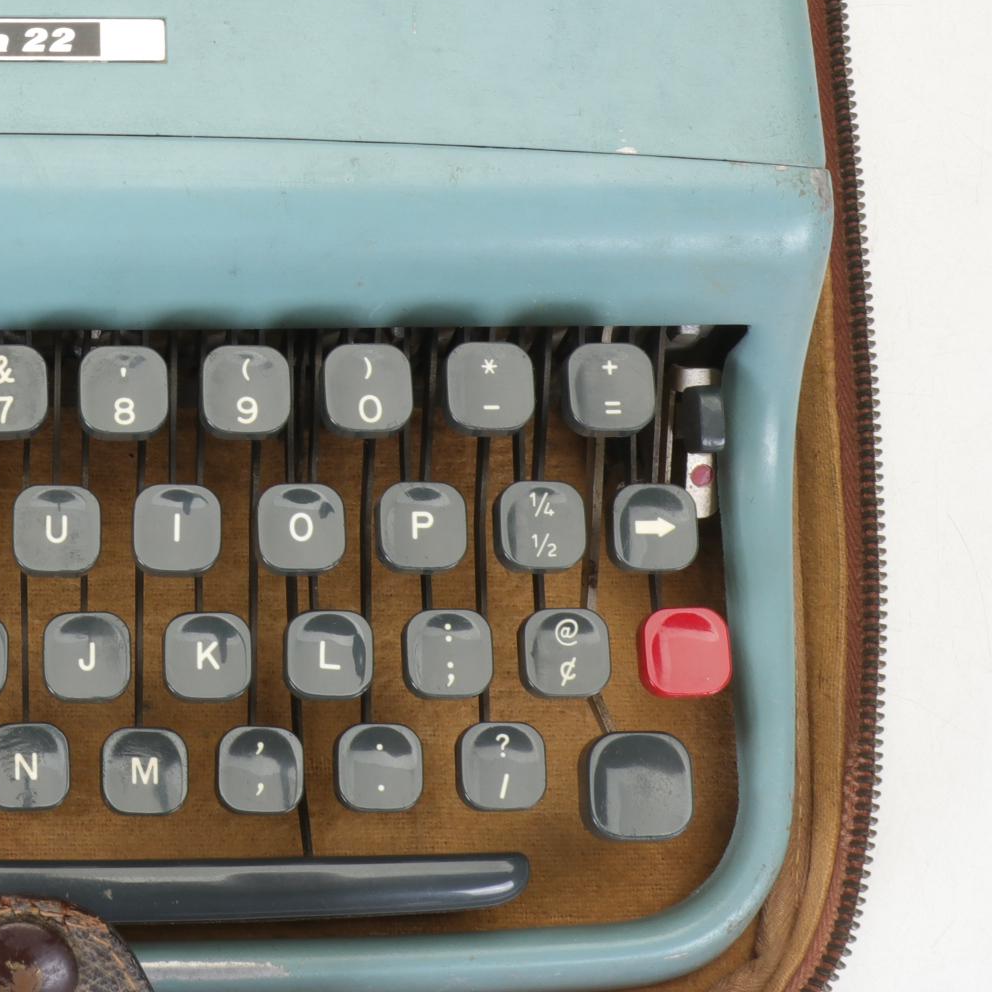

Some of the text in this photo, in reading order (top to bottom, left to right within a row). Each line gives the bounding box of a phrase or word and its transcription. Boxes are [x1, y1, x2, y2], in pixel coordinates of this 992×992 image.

[22, 27, 75, 54] 22
[241, 358, 251, 382] (
[363, 356, 373, 380] )
[600, 359, 620, 377] +
[111, 396, 138, 427] 8
[234, 395, 260, 426] 9
[602, 399, 624, 416] =
[45, 514, 68, 544] U
[288, 512, 314, 542] O
[411, 511, 434, 540] P
[554, 619, 579, 647] @
[78, 642, 96, 672] J
[196, 641, 221, 671] K
[319, 640, 341, 671] L
[495, 734, 510, 758] ?
[14, 753, 39, 781] N
[131, 757, 159, 785] M
